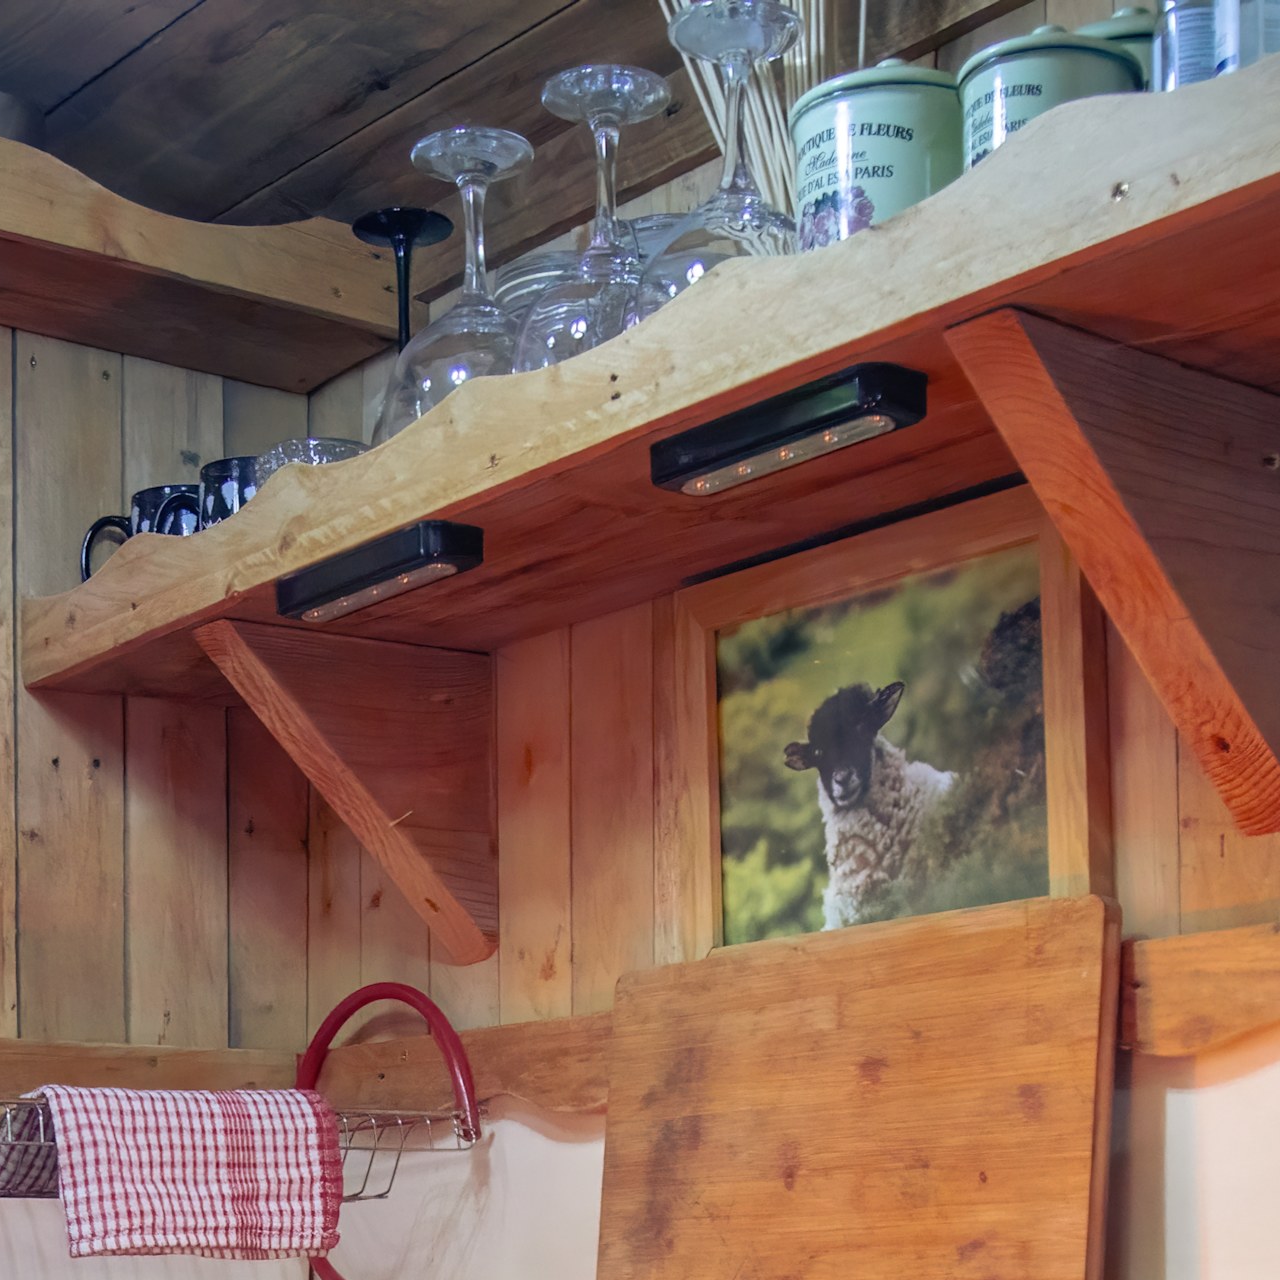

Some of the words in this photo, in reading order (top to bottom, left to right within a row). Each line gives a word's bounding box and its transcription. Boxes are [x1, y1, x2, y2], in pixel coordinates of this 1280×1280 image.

[798, 127, 836, 161] OUTIQUE
[860, 122, 915, 141] FLEURS
[855, 165, 894, 180] PARIS
